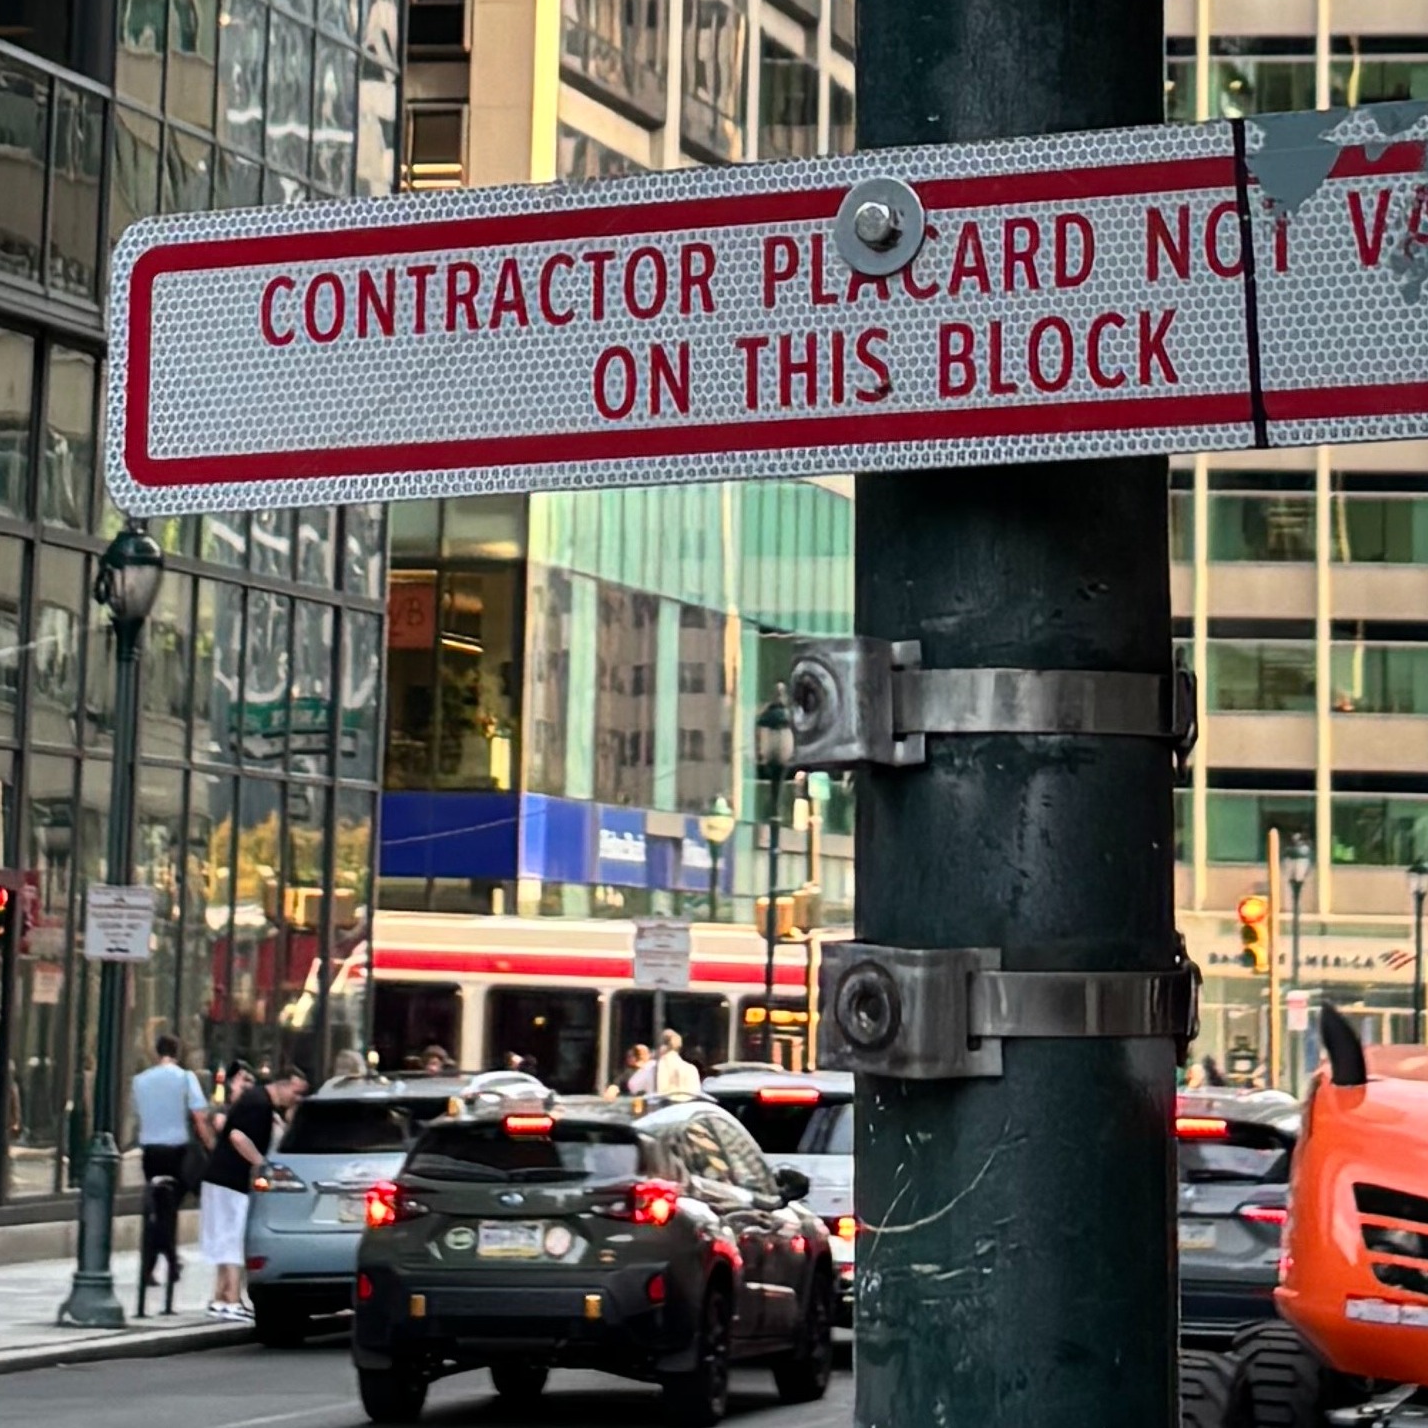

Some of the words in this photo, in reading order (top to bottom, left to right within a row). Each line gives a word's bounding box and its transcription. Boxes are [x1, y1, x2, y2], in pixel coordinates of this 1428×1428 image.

[260, 243, 716, 346] CONTRACTOR
[593, 343, 690, 421] ON
[737, 328, 889, 411] THIS
[938, 310, 1177, 399] BLOCK
